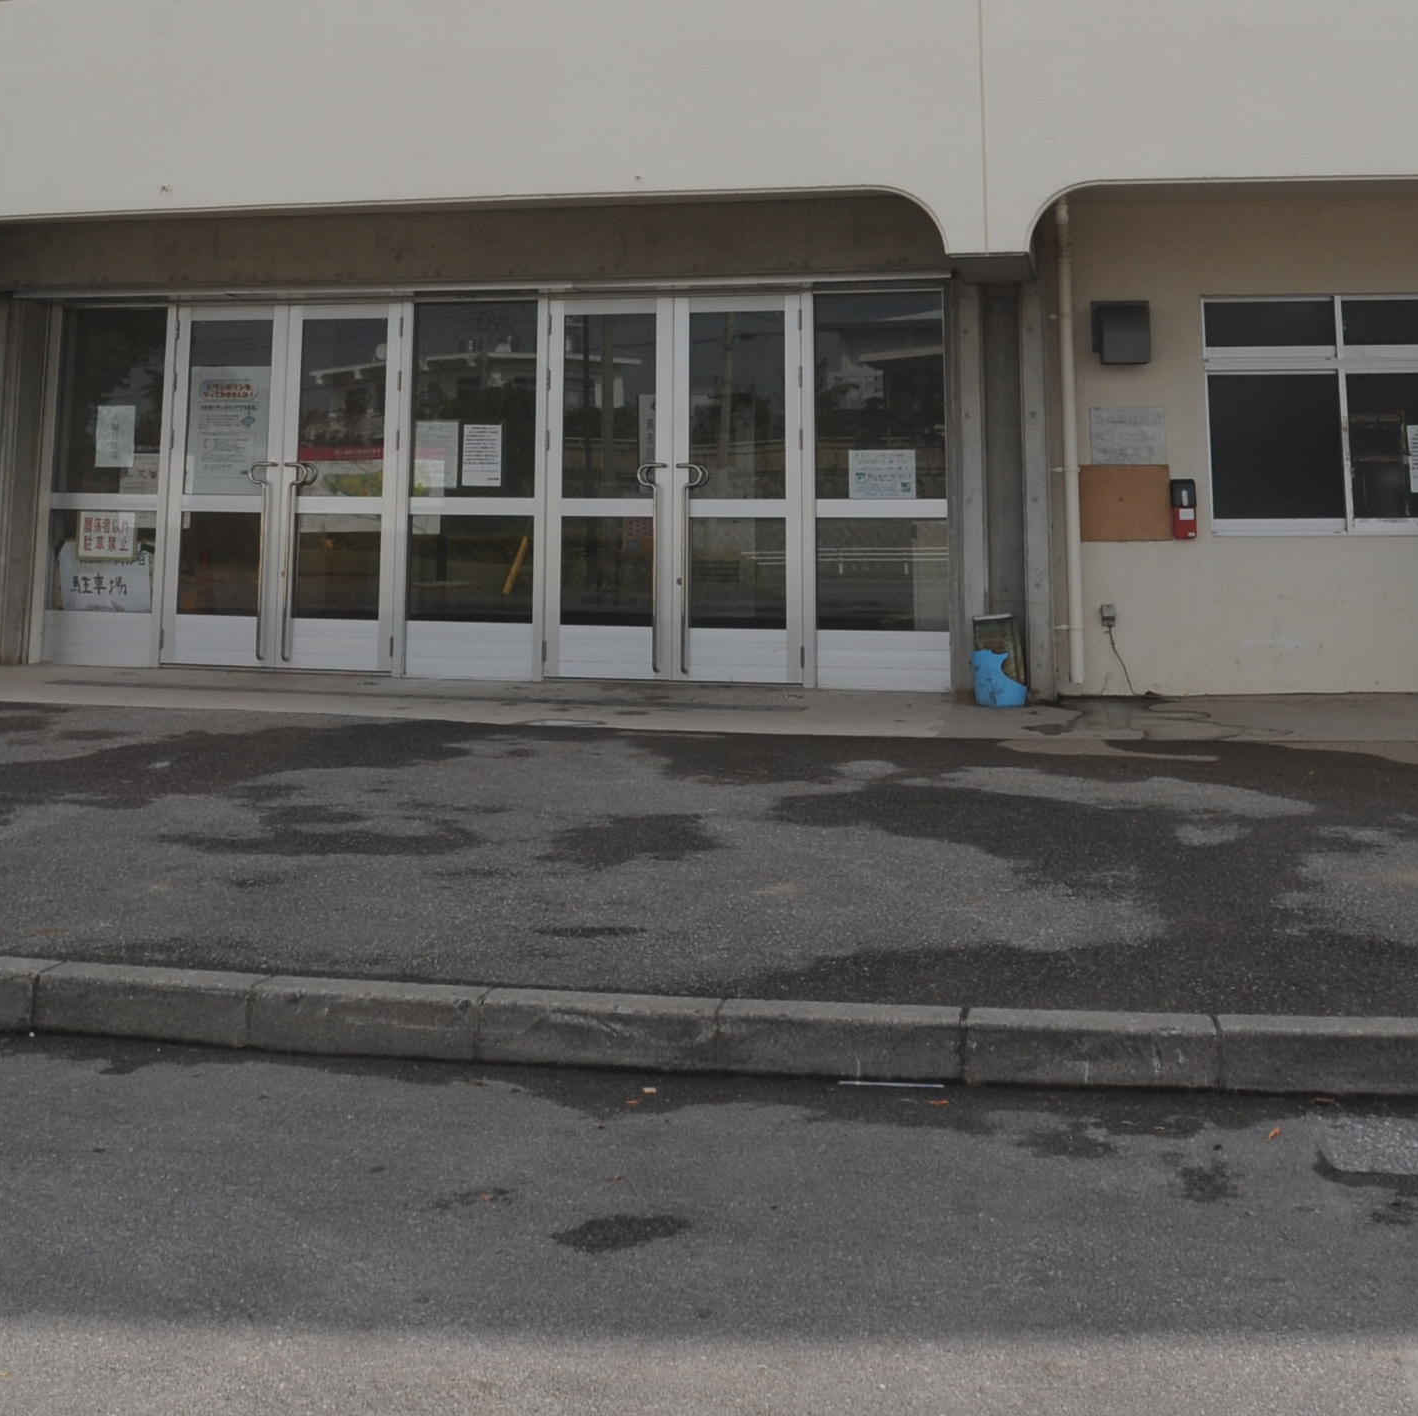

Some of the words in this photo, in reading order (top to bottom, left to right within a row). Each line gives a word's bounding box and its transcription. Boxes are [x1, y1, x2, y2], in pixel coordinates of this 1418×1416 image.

[83, 536, 129, 552] 駐車禁止
[71, 572, 128, 596] 駐車場
